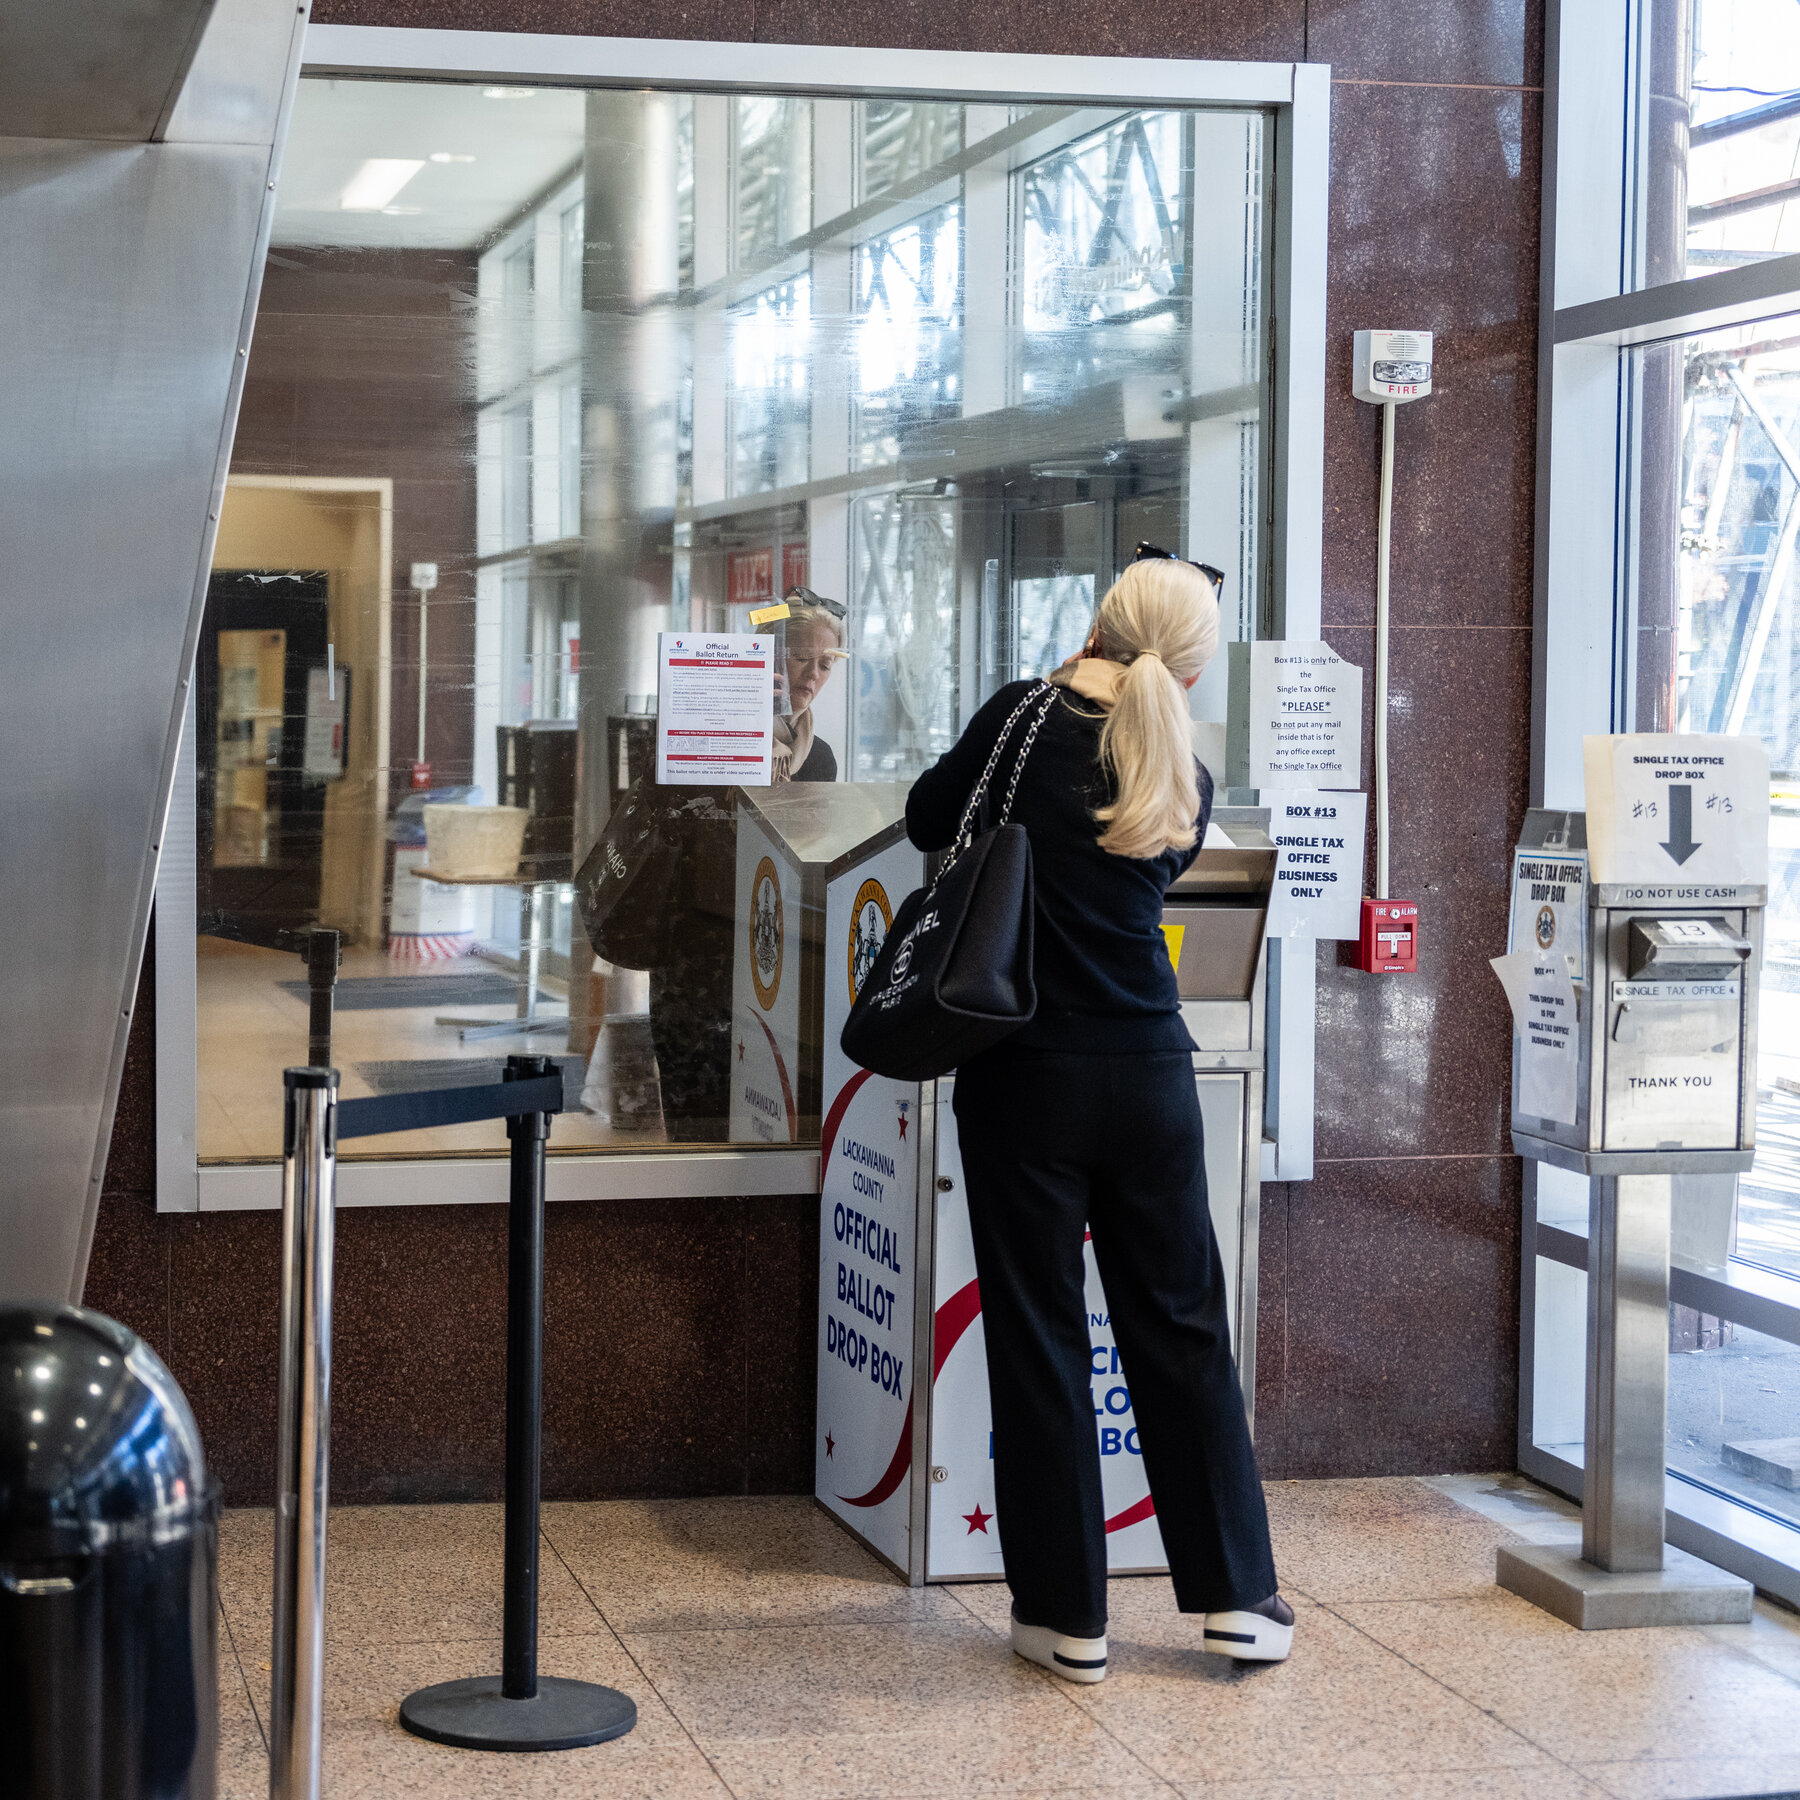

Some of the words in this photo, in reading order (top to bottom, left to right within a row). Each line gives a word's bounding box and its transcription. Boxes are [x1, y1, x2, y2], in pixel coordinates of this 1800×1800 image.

[1388, 385, 1418, 394] FIRE
[1311, 657, 1326, 666] only
[1277, 686, 1298, 695] Single
[1297, 721, 1309, 731] put
[1310, 722, 1323, 730] any
[1290, 748, 1310, 756] office
[1311, 749, 1335, 757] except
[1633, 756, 1669, 765] SINGLE
[1671, 756, 1689, 765] TAX
[1692, 757, 1725, 766] OFFICE
[1284, 763, 1304, 771] Single
[1655, 771, 1683, 779] DROP
[1685, 771, 1705, 779] BOX
[1705, 793, 1733, 814] #13
[1286, 806, 1311, 817] BOX
[1314, 807, 1337, 818] #13
[1632, 800, 1658, 819] #13
[1275, 836, 1319, 847] SINGLE
[1321, 838, 1344, 848] TAX
[1287, 853, 1330, 864] OFFICE
[1278, 870, 1338, 882] BUSINESS
[1519, 862, 1542, 882] SINGLE
[1544, 864, 1558, 882] TAX
[1559, 865, 1583, 884] OFFICE
[1291, 887, 1323, 898] ONLY
[1531, 883, 1549, 901] DROP
[1551, 886, 1566, 903] BOX
[1625, 889, 1643, 899] DO
[1648, 889, 1673, 899] NOT
[1677, 889, 1700, 898] USE
[1705, 888, 1737, 898] CASH
[1375, 907, 1387, 916] FIRE
[1400, 907, 1418, 916] ALARM
[1674, 925, 1706, 936] 13
[1534, 967, 1545, 975] BOX
[1625, 987, 1659, 996] SINGLE
[1667, 987, 1685, 996] TAX
[1692, 986, 1726, 995] OFFICE
[1529, 994, 1540, 1002] THIS
[1540, 996, 1554, 1004] DROP
[1555, 997, 1564, 1006] BOX
[1541, 1009, 1546, 1017] IS
[1546, 1010, 1556, 1018] FOR
[1528, 1021, 1544, 1031] SINGLE
[1544, 1024, 1552, 1032] TAX
[1553, 1026, 1570, 1035] OFFICE
[1531, 1036, 1552, 1046] BUSINESS
[1552, 1040, 1565, 1049] ONLY
[1629, 1077, 1677, 1088] THANK
[1683, 1077, 1712, 1087] YOU
[842, 1137, 895, 1179] LACKAWANNA
[853, 1171, 884, 1203] COUNTY
[834, 1203, 900, 1274] OFFICIAL
[838, 1262, 895, 1331] BALLOT
[827, 1314, 867, 1373] DROP
[871, 1342, 903, 1401] BOX
[1100, 1428, 1142, 1455] BO
